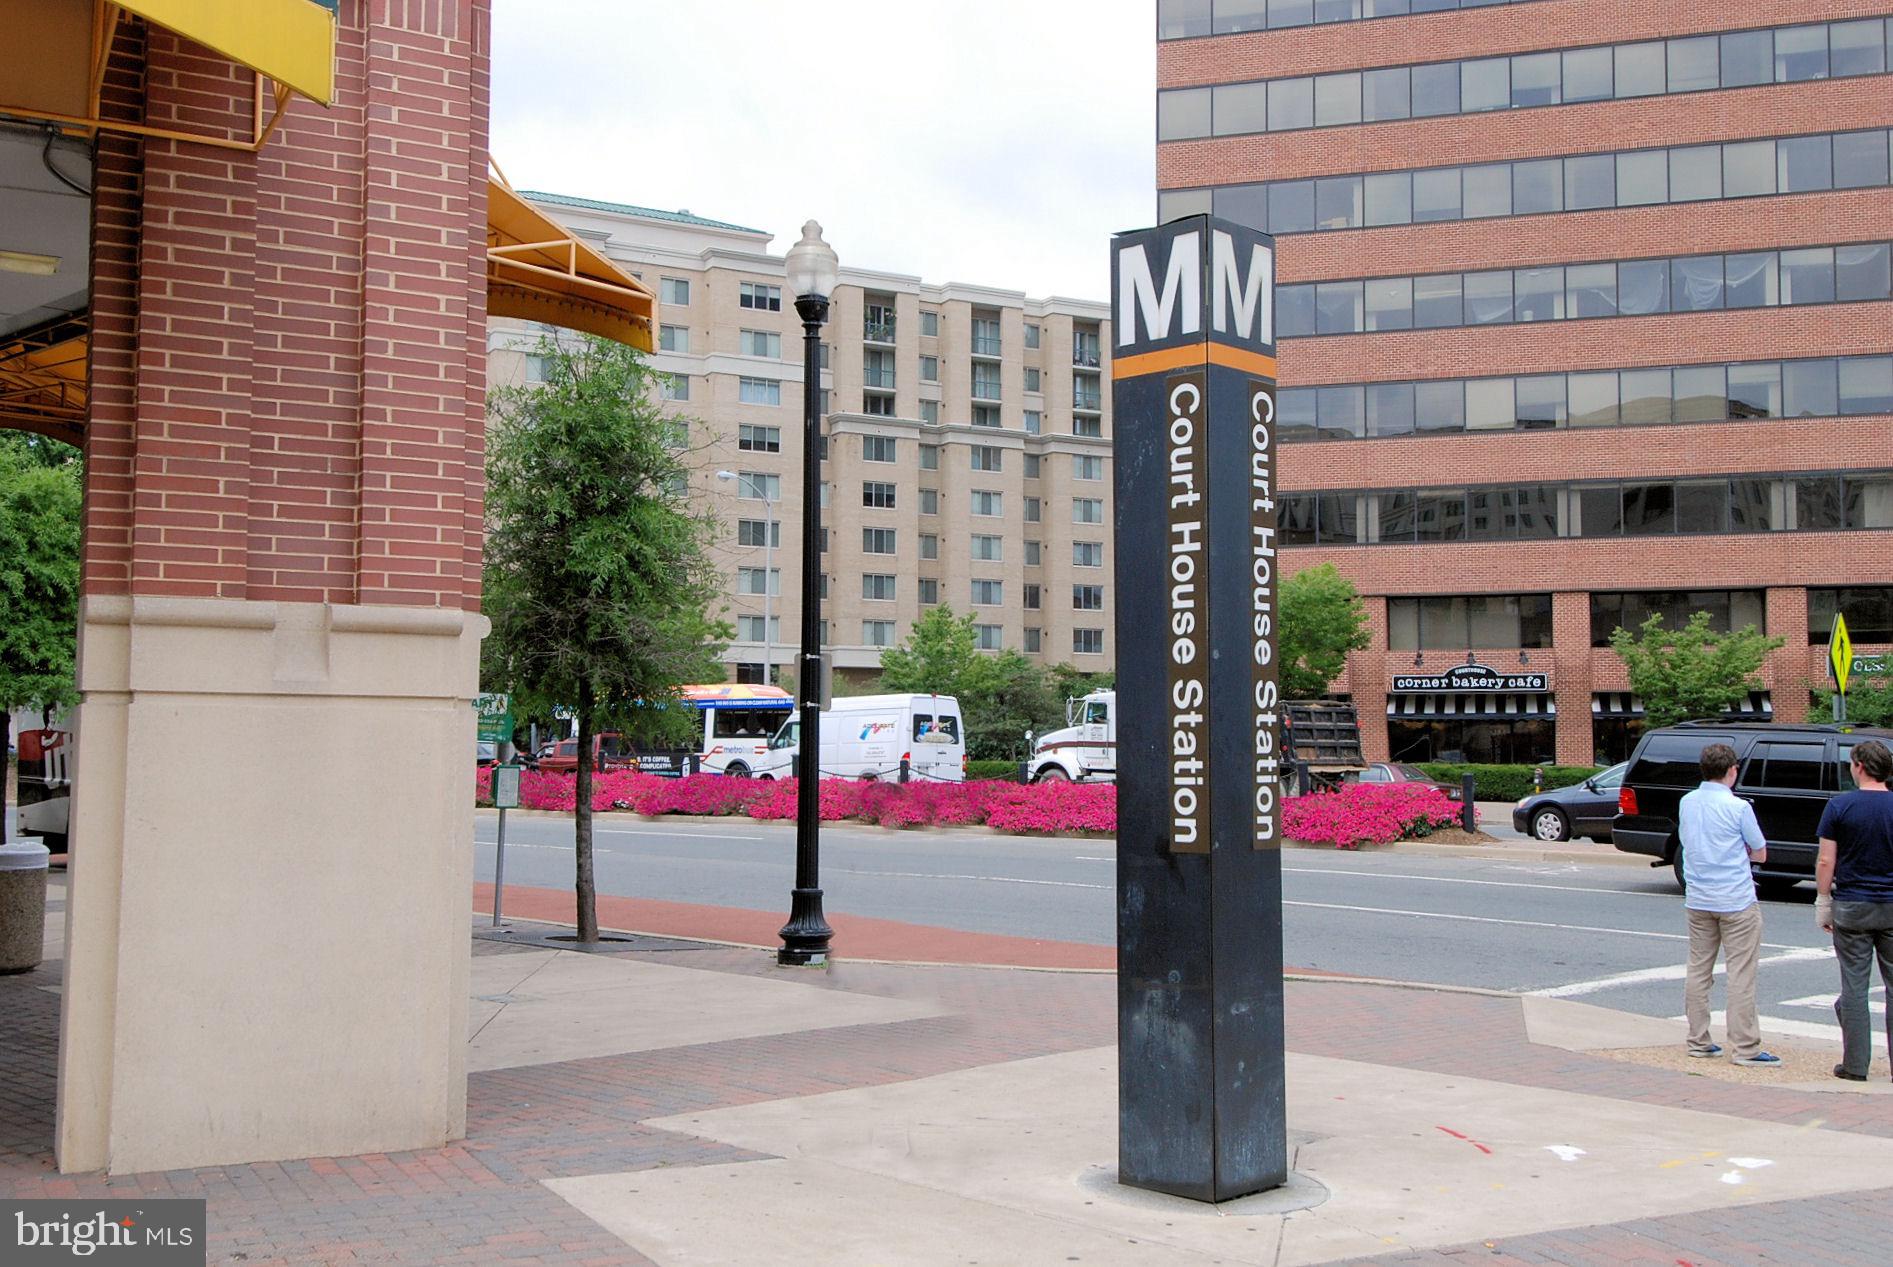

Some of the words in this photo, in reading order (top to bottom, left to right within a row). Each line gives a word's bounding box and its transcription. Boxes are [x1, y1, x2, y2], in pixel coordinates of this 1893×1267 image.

[1118, 230, 1201, 347] M
[1212, 229, 1273, 346] M
[1169, 382, 1201, 509] Court
[1252, 391, 1274, 513] Court
[1171, 521, 1202, 665] House
[1253, 525, 1275, 666] House
[1397, 678, 1448, 688] corner
[1451, 676, 1505, 689] bakery
[1508, 676, 1542, 688] cafe
[1172, 679, 1204, 843] Station
[1255, 679, 1278, 840] Station
